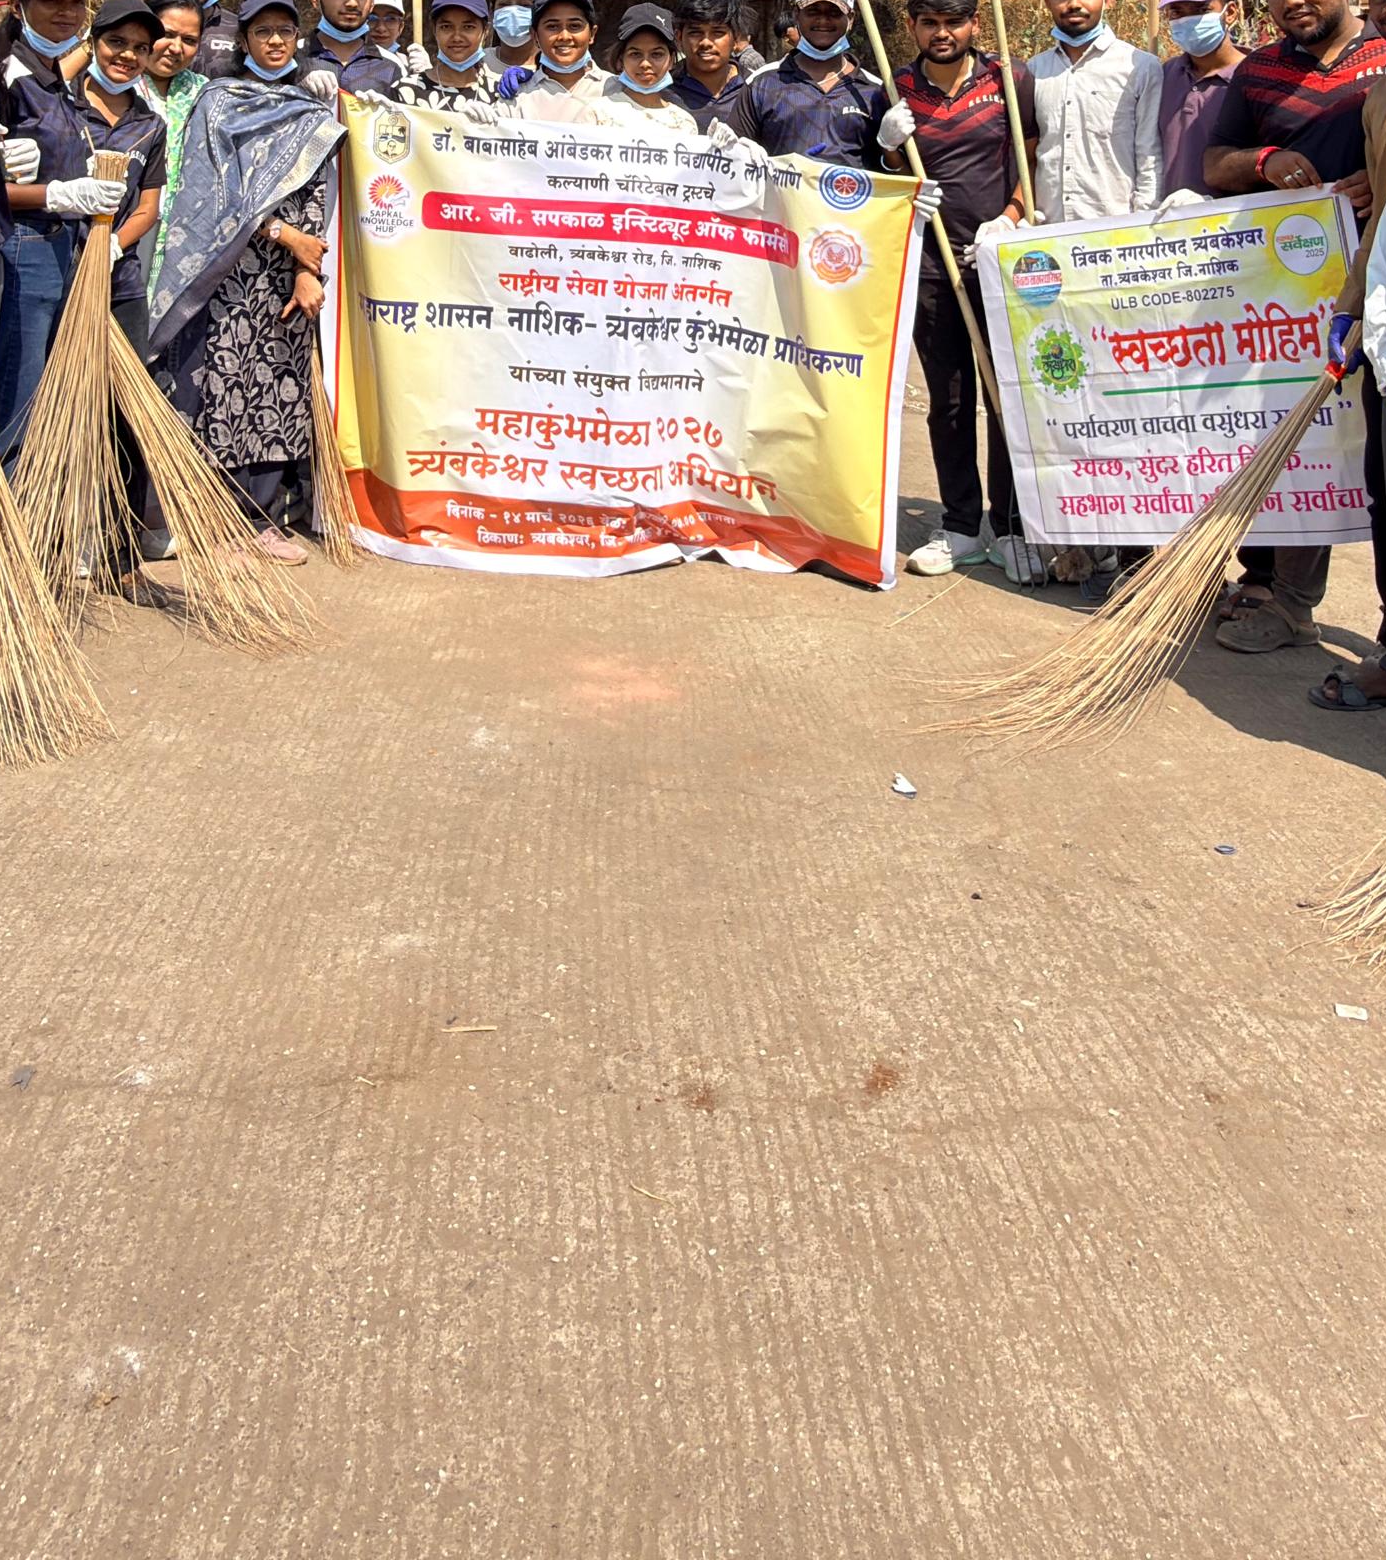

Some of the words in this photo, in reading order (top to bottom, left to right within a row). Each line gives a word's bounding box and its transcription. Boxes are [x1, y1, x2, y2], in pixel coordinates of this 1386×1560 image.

[432, 126, 457, 153] डॉ.
[463, 131, 539, 160] बाबासाहेब
[544, 134, 613, 163] आंबेडकर
[618, 139, 669, 166] तांत्रिक
[674, 142, 737, 181] विद्यापीठ,
[546, 172, 610, 192] कल्याणी
[682, 181, 716, 203] ट्रस्टचे
[360, 215, 414, 228] KNOWLEDGE
[369, 208, 404, 219] SAPKAL
[375, 223, 394, 234] HUB
[440, 202, 481, 223] आर.
[489, 201, 523, 226] जी.
[531, 209, 605, 229] सपकाळ
[695, 216, 736, 241] ऑफ
[508, 242, 564, 263] वाढोली,
[633, 248, 656, 268] रोड,
[661, 250, 676, 267] जि.
[681, 252, 722, 272] नाशिक
[1071, 245, 1113, 268] त्रिंबक
[1116, 237, 1188, 263] नगरपरिषद
[1280, 234, 1325, 252] सर्वेक्षण
[1305, 247, 1325, 258] 2025
[498, 268, 560, 298] राष्ट्रीय
[566, 269, 609, 298] सेवा
[613, 273, 668, 301] योजना
[671, 277, 733, 308] अंतर्गत
[1111, 296, 1138, 310] ULB
[1141, 284, 1235, 307] CODE-802275
[425, 301, 493, 330] शासन
[685, 310, 769, 357] कुंभमेळा
[772, 335, 863, 378] प्राधिकरण
[508, 359, 567, 386] यांच्या
[573, 364, 631, 397] संयुक्त
[638, 368, 706, 393] विद्यमानाने
[474, 402, 651, 450] महाकुंभमेळा
[1062, 414, 1138, 439] पर्यावरण
[1140, 414, 1198, 435] वाचवा
[1201, 404, 1268, 438] वसुंधरा
[559, 460, 664, 493] स्वच्छता
[667, 452, 777, 501] अभियान
[1070, 457, 1132, 481] स्वच्छ,
[1135, 448, 1180, 483] सुंदर
[1184, 446, 1234, 476] हरित
[445, 498, 486, 521] दिनांक
[1056, 494, 1126, 517] सहभाग
[1130, 486, 1195, 515] सर्वांचा
[1288, 482, 1365, 512] सर्वांचा
